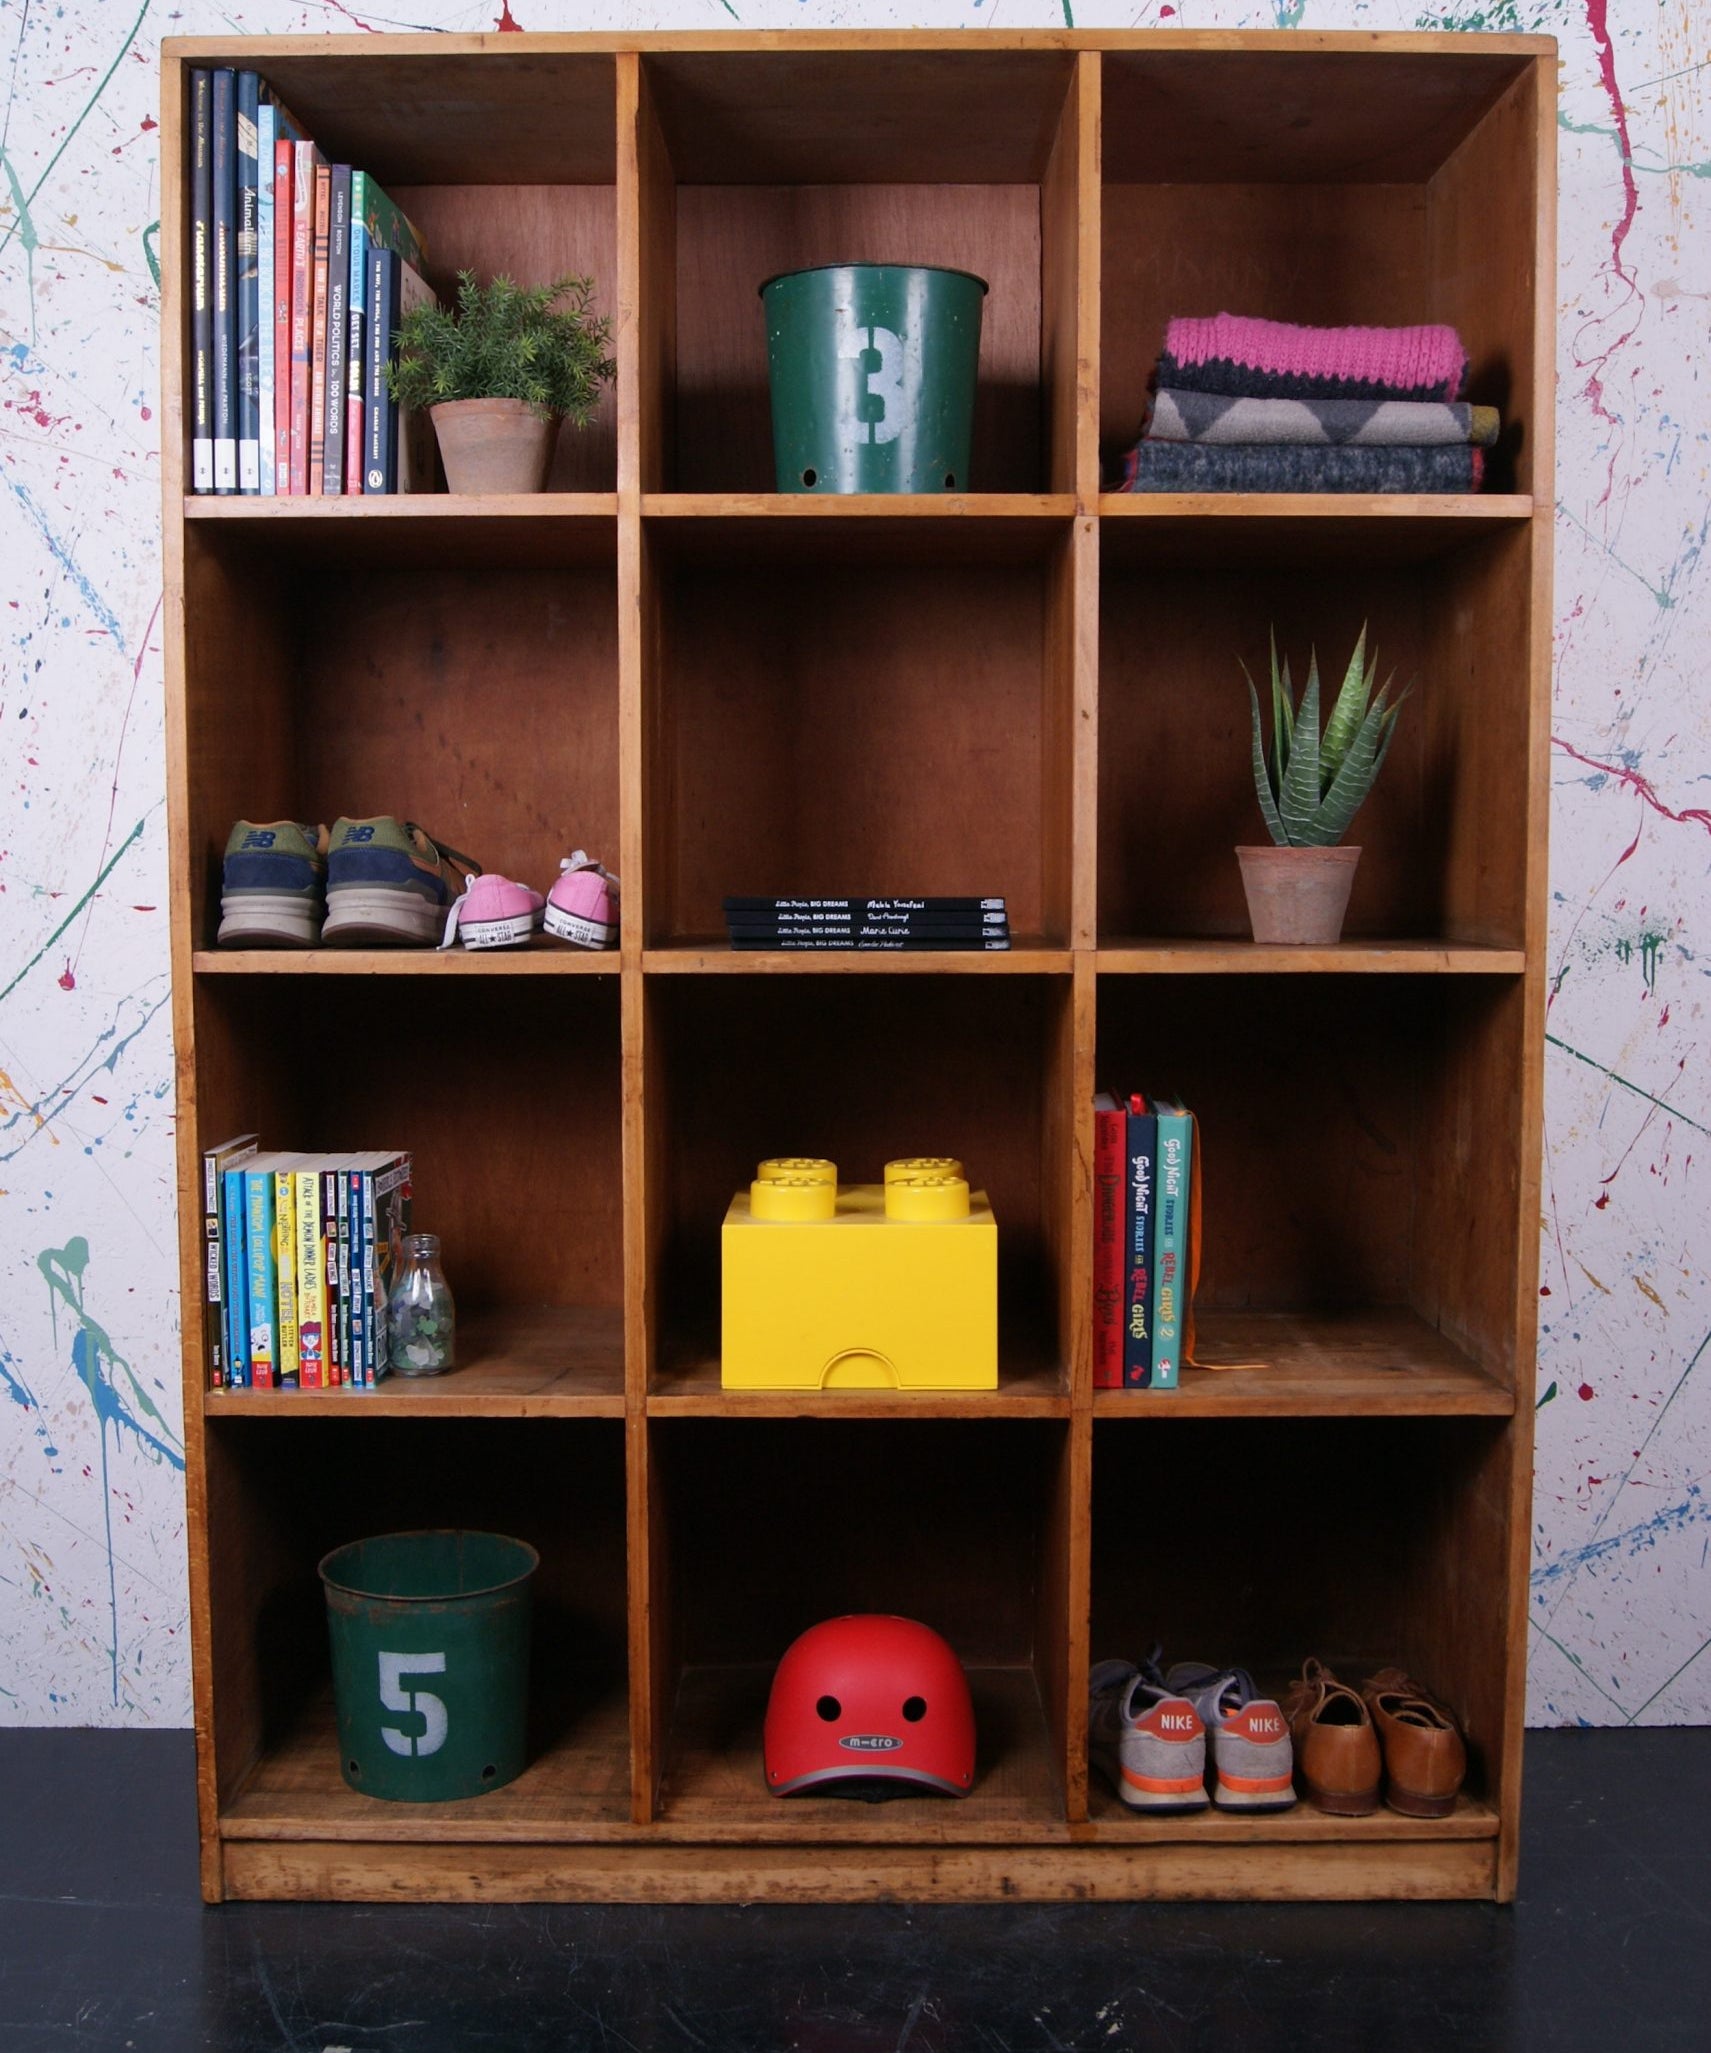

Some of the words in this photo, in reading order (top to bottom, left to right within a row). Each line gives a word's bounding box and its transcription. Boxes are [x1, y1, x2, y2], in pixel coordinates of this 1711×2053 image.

[244, 186, 256, 255] Animalium
[354, 228, 361, 240] ON
[317, 296, 325, 316] TALK
[333, 284, 342, 319] WORLD
[351, 314, 360, 330] GET
[332, 322, 340, 366] POLITICS
[331, 380, 339, 397] 100
[838, 326, 916, 444] 3
[330, 399, 338, 434] WORDS
[477, 924, 510, 932] CONVERSE
[556, 924, 567, 934] ALL
[574, 931, 589, 942] STAR
[560, 918, 591, 932] CONVERSE
[860, 926, 887, 935] Marie
[479, 934, 489, 944] ALL
[497, 932, 512, 942] STAR
[251, 1179, 264, 1191] THE
[303, 1177, 314, 1198] ATTACK
[251, 1195, 264, 1232] PHANTOM
[304, 1210, 313, 1218] THE
[1165, 1200, 1175, 1235] STORIES
[279, 1214, 291, 1247] NOTHING
[303, 1221, 315, 1242] DEMON
[1135, 1215, 1145, 1252] STORIES
[209, 1244, 217, 1269] WICKED
[252, 1235, 265, 1272] LOLLIPOP
[303, 1244, 315, 1265] DINNER
[304, 1268, 317, 1290] LADIES
[1160, 1252, 1176, 1286] REBEL
[210, 1274, 219, 1299] WORDS
[1131, 1268, 1148, 1303] REBEL
[280, 1282, 294, 1323] HOTEL
[1158, 1287, 1176, 1323] GIRLS
[1129, 1304, 1148, 1339] GIRLS
[1160, 1328, 1175, 1337] 2
[378, 1651, 448, 1757] 5
[1160, 1713, 1192, 1731] NIKE
[1249, 1717, 1280, 1732] NIKE
